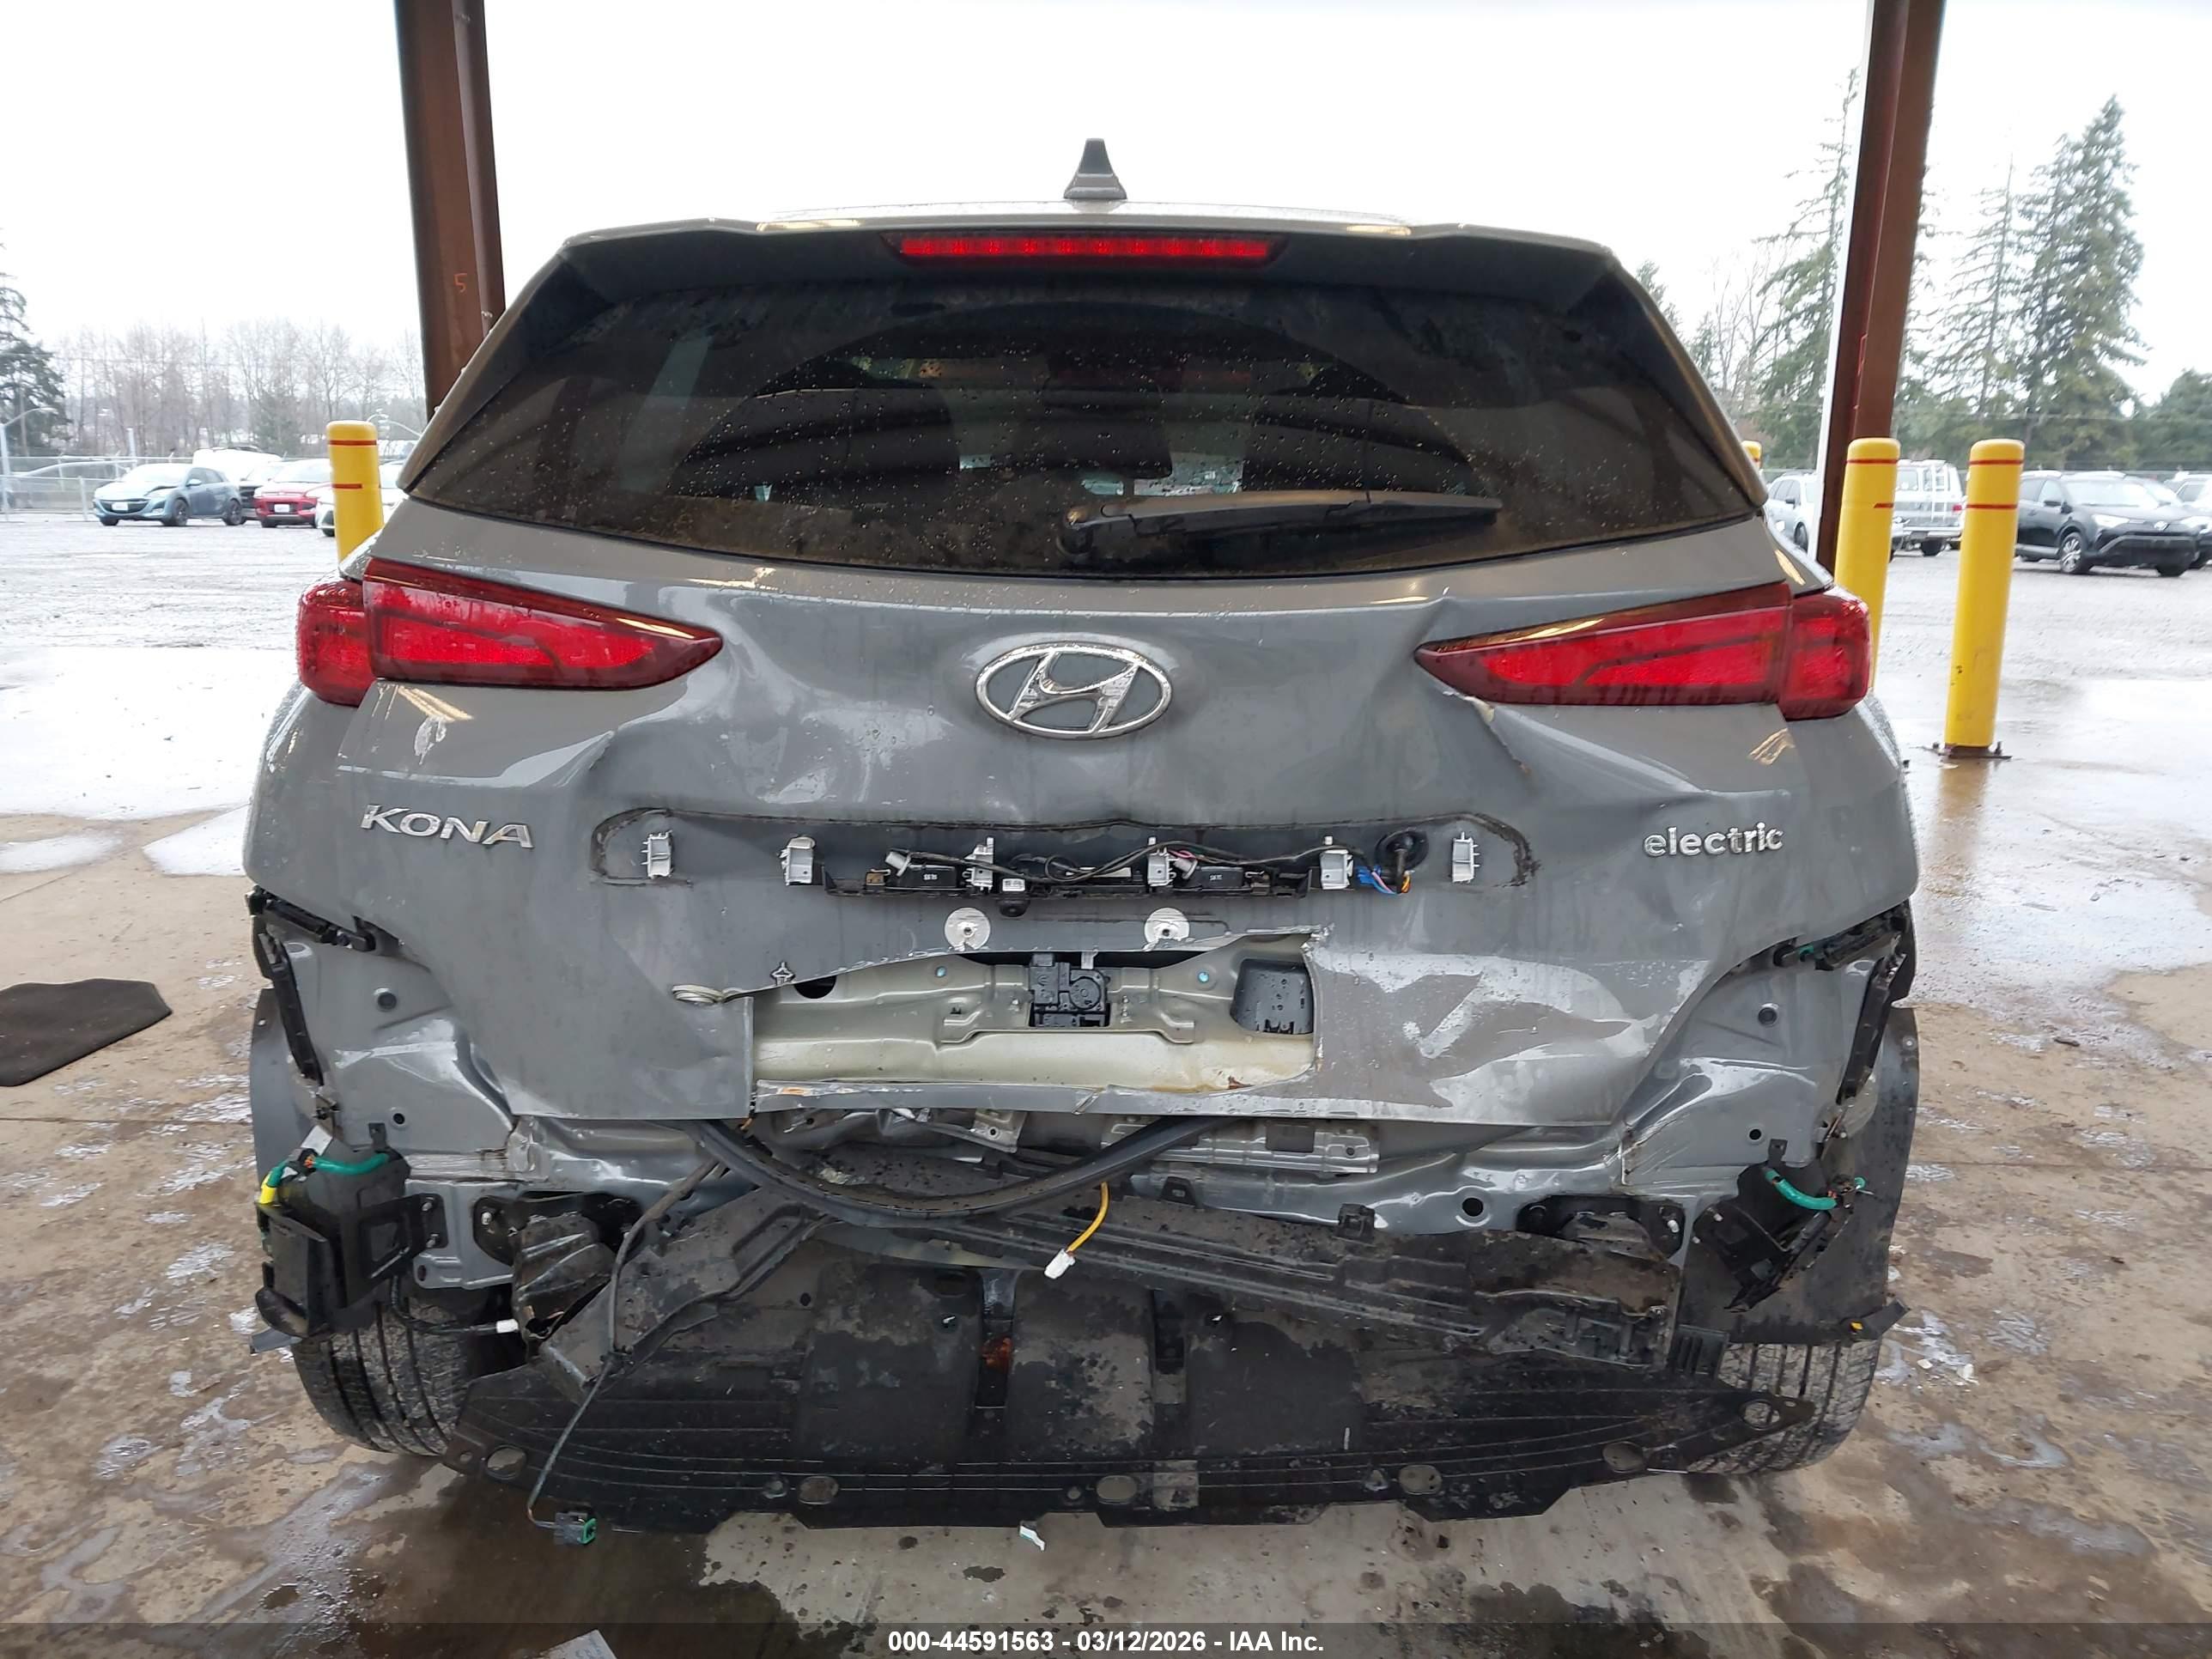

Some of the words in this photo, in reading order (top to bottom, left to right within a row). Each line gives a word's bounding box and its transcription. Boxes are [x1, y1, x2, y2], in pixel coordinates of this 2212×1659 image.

[453, 272, 468, 293] 5
[360, 803, 535, 848] KONA
[1644, 822, 1784, 857] electric
